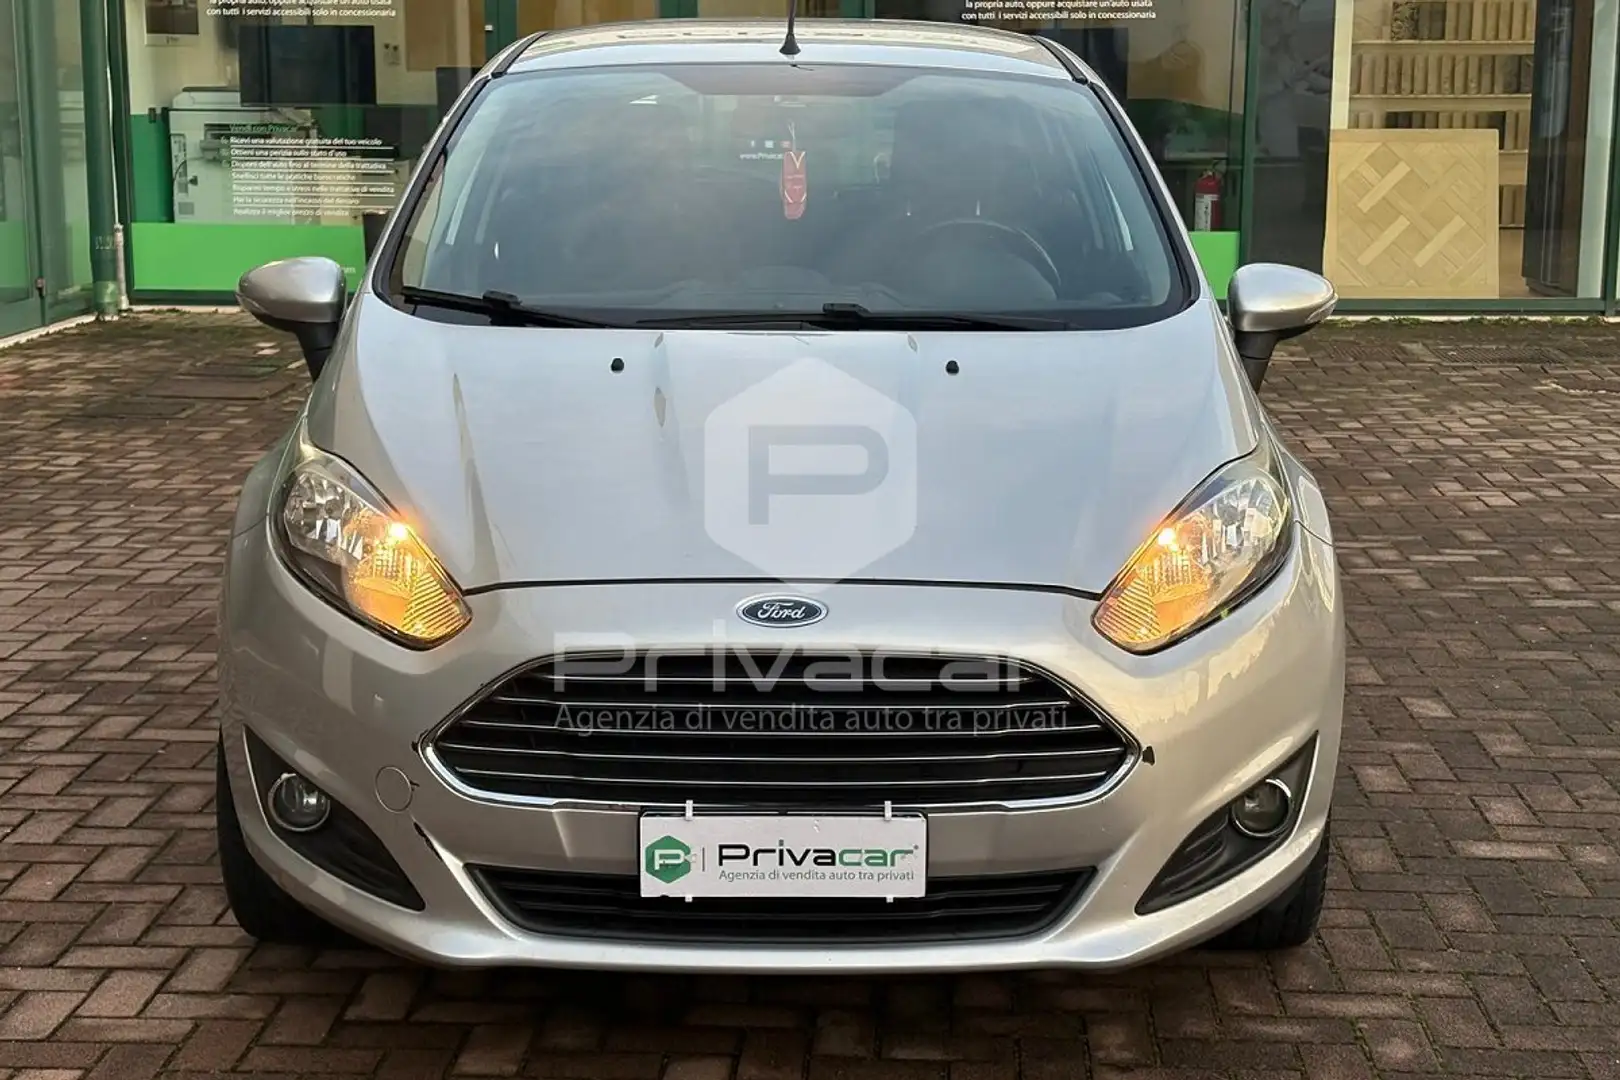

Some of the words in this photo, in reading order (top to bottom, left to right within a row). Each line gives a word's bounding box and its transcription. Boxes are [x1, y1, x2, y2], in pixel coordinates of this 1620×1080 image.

[974, 0, 1003, 8] propria
[1026, 0, 1056, 8] oppure
[1057, 0, 1098, 8] acquistare
[1130, 0, 1152, 8] usata
[206, 8, 221, 16] con
[222, 8, 240, 16] tutti
[246, 8, 271, 16] servizi
[272, 8, 312, 16] accessibili
[312, 8, 329, 16] solo
[330, 8, 338, 16] in
[338, 8, 396, 16] concessionaria
[961, 11, 976, 20] con
[978, 11, 995, 20] tutti
[1002, 11, 1028, 20] servizi
[1028, 11, 1069, 20] accessibili
[1070, 11, 1088, 20] solo
[1088, 11, 1096, 20] in
[1098, 11, 1156, 20] concessionaria
[230, 136, 251, 145] Ricevi
[252, 136, 264, 145] una
[265, 137, 304, 145] valutazione
[255, 148, 268, 157] una
[360, 185, 368, 193] di
[368, 185, 394, 193] vendita
[757, 602, 807, 619] Ford
[719, 870, 766, 882] Agenzia
[768, 869, 780, 880] di
[782, 869, 827, 880] vendita
[829, 871, 856, 880] auto
[858, 871, 876, 880] tra
[877, 870, 915, 882] privati
